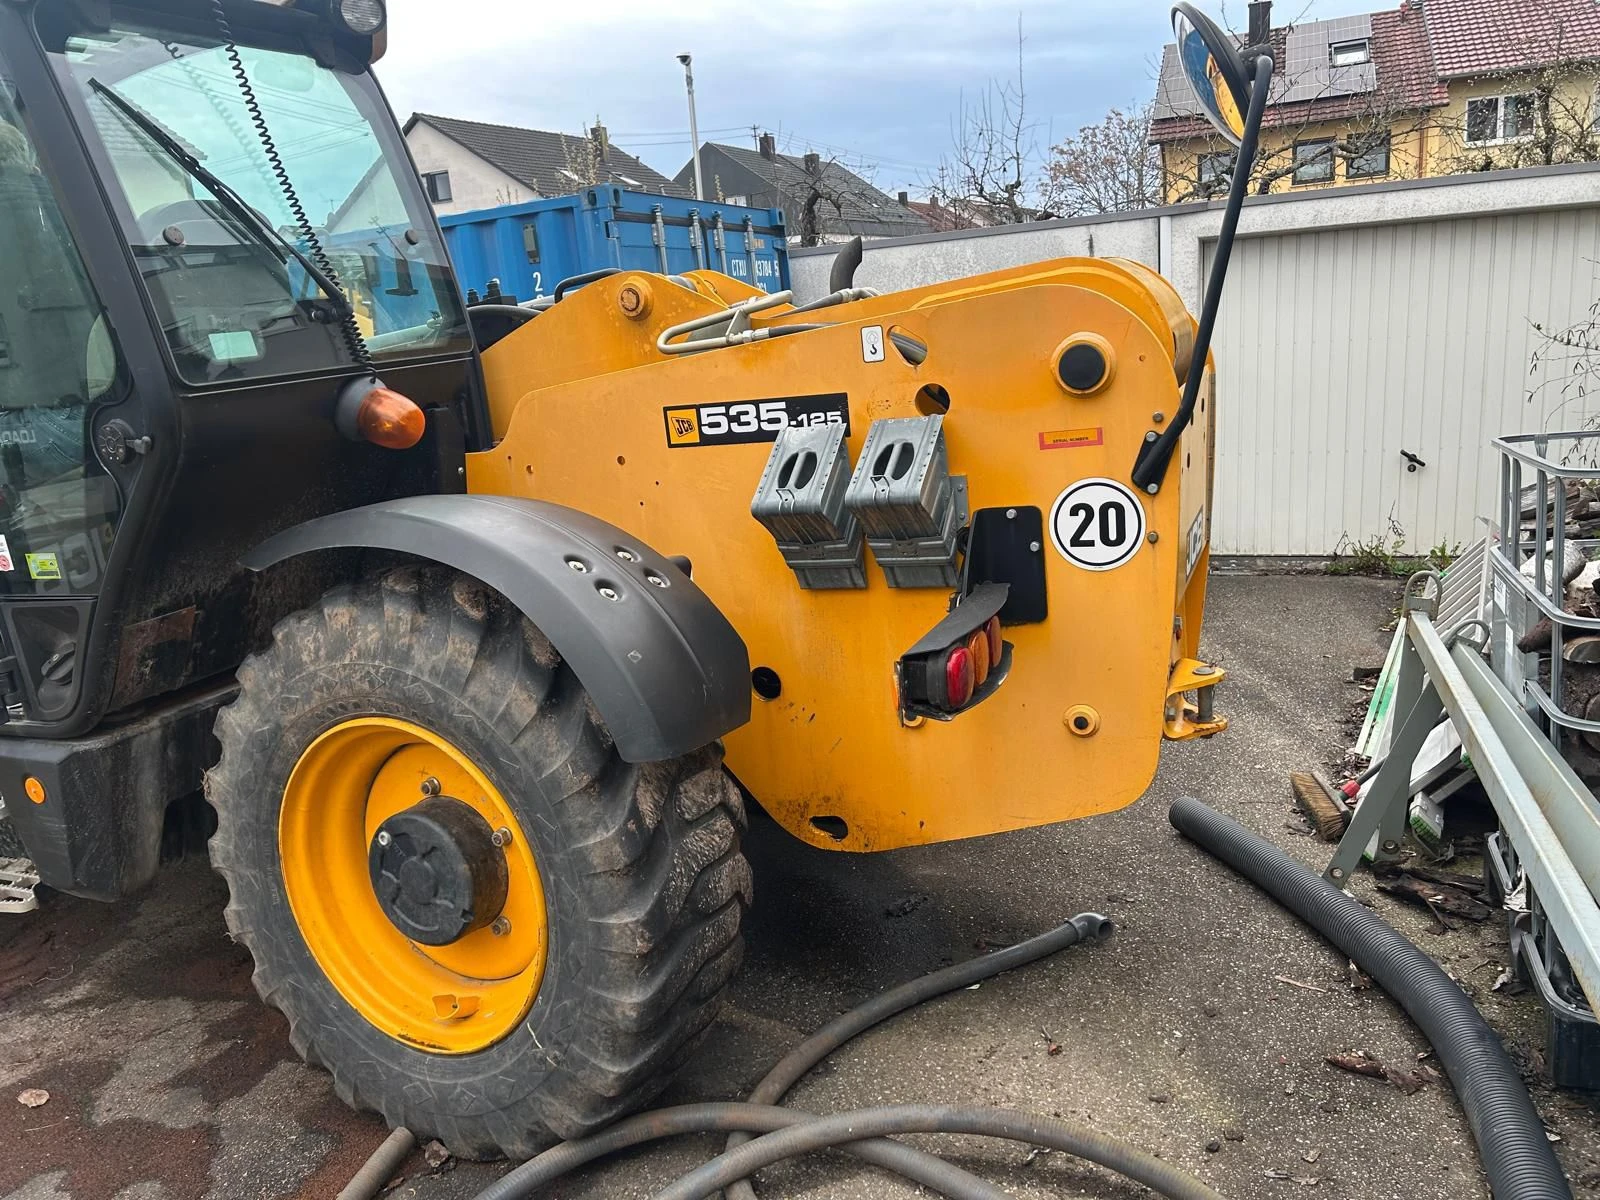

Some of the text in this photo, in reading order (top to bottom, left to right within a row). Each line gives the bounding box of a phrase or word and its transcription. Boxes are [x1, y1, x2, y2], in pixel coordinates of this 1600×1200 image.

[532, 271, 543, 291] 2
[675, 418, 694, 435] JCB
[1069, 501, 1126, 547] 20
[1187, 511, 1203, 576] JCB
